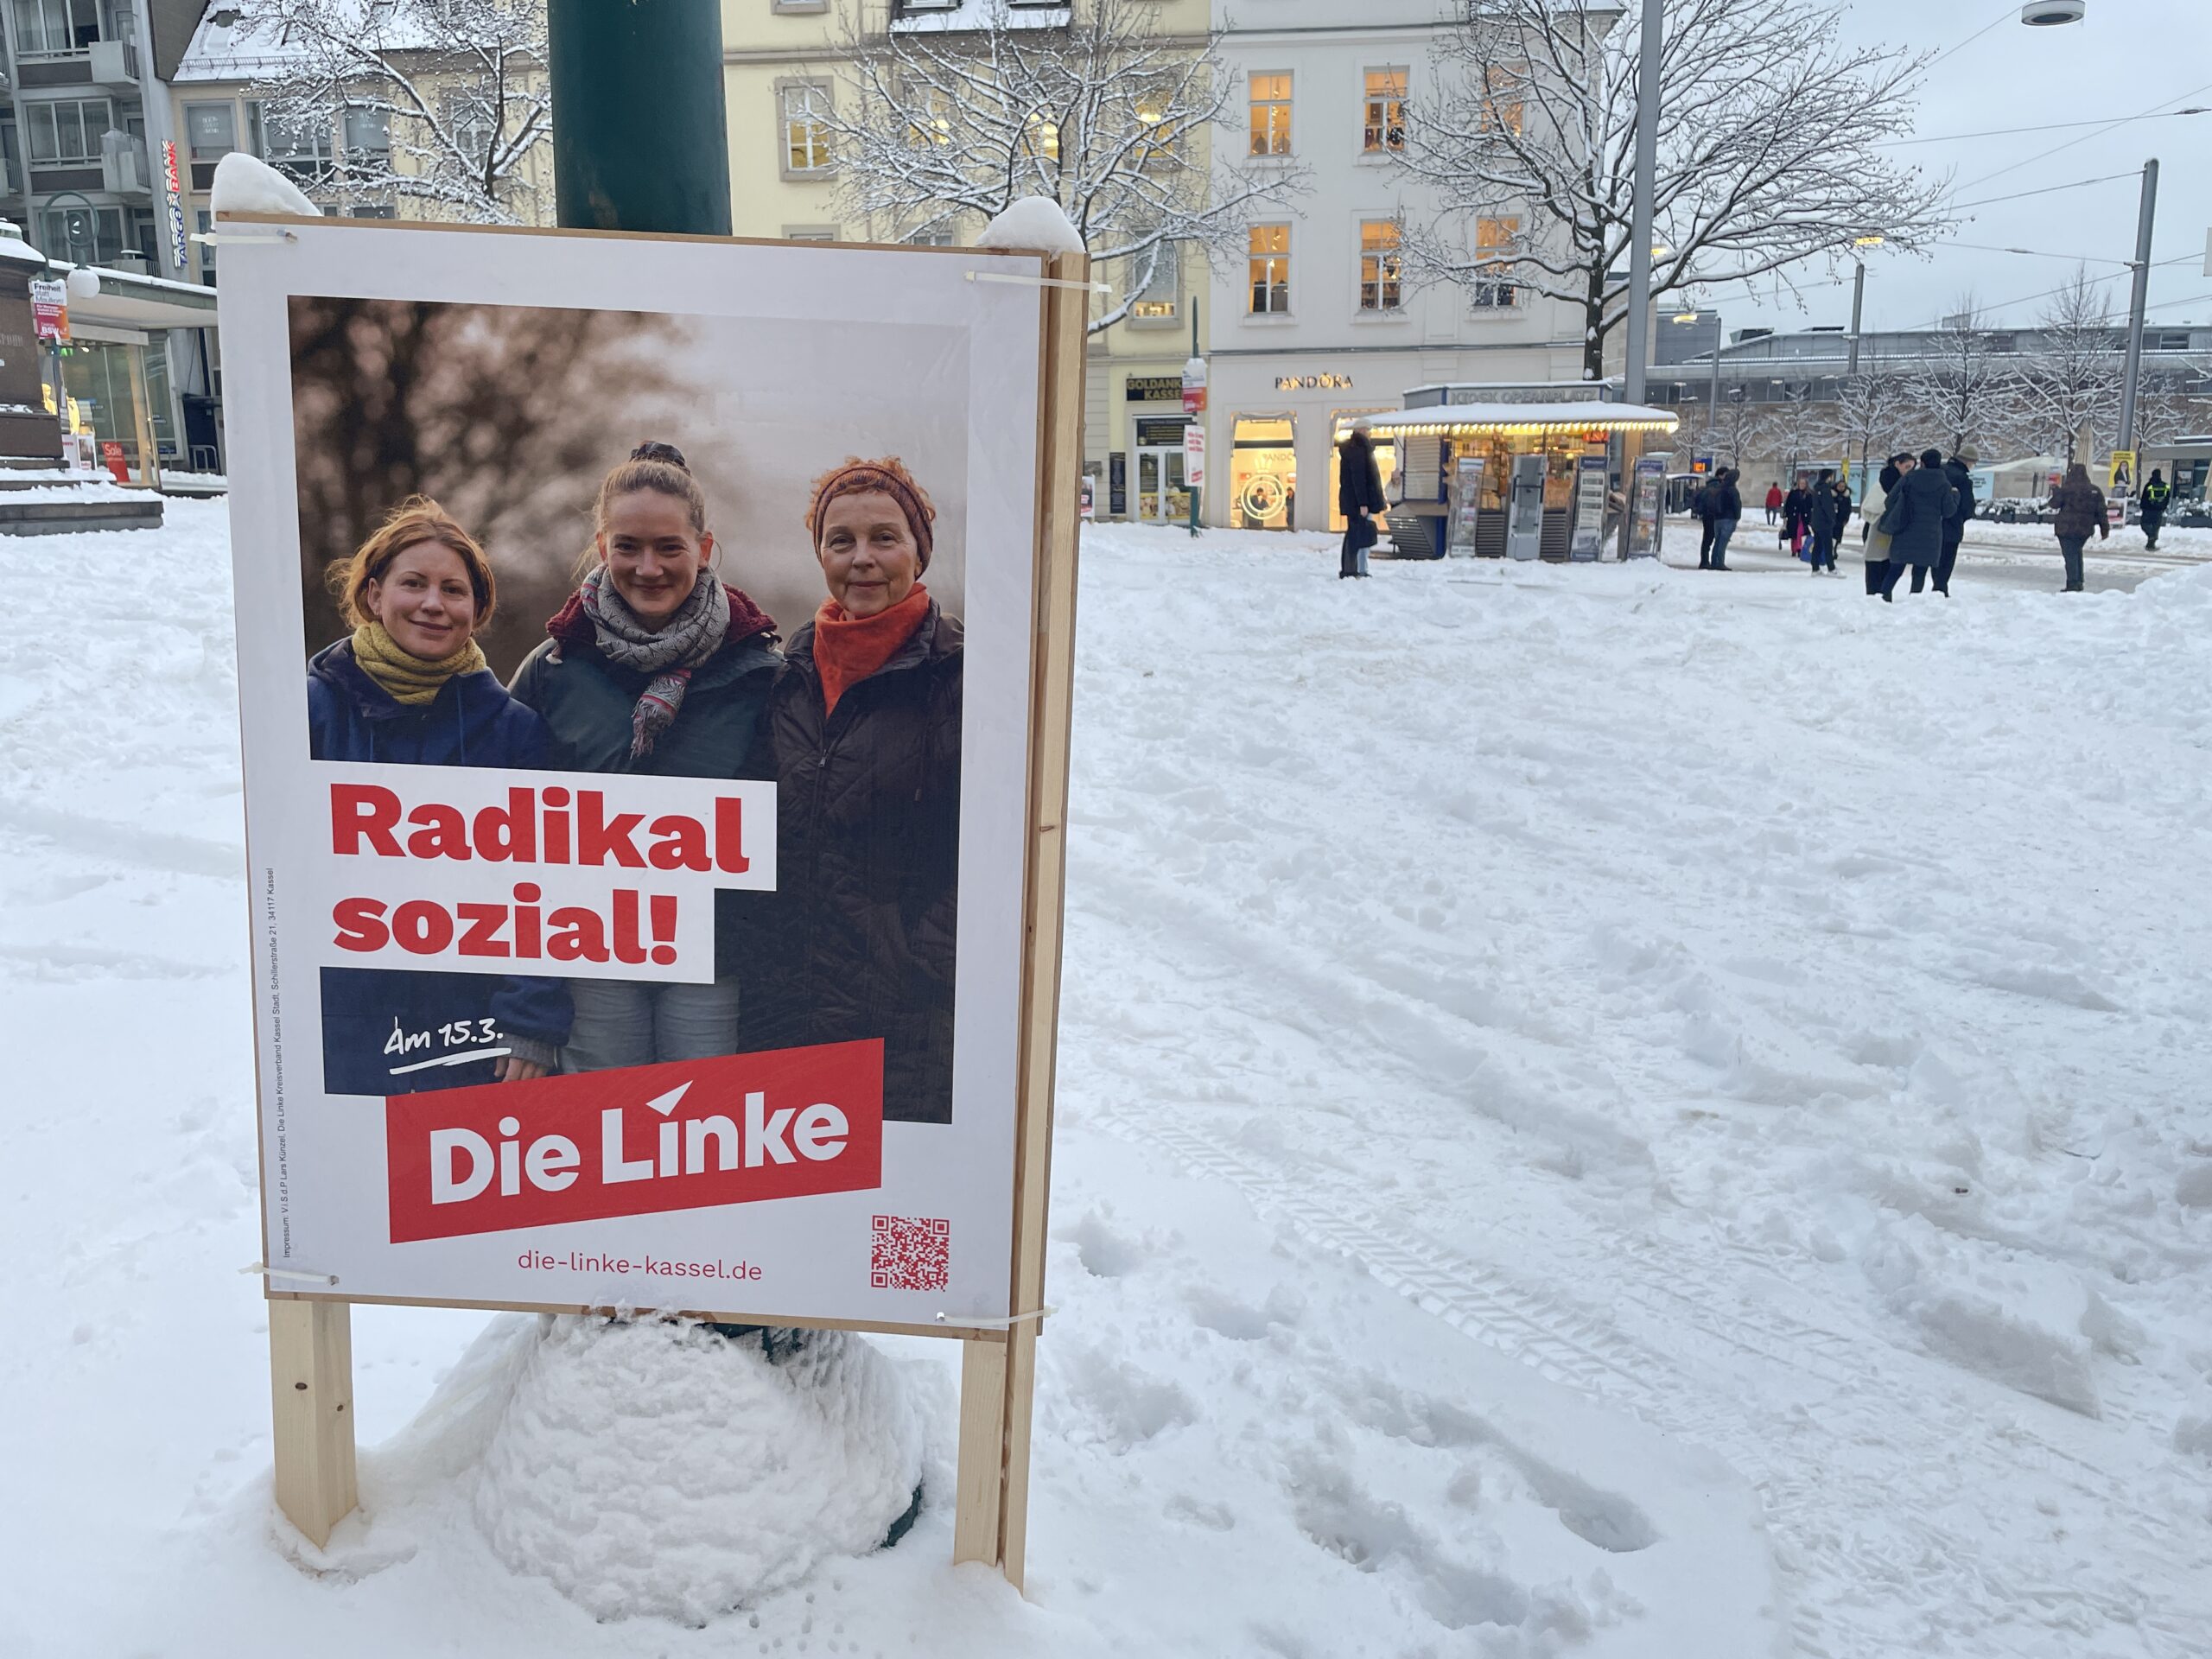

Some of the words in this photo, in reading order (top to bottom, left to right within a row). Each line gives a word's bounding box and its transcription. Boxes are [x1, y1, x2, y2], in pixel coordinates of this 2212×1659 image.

[34, 283, 61, 293] Freiheit
[1127, 378, 1182, 390] GOLDANK
[1145, 389, 1182, 400] KASSE
[1452, 391, 1497, 404] KIOSK
[1501, 389, 1596, 404] OPERNPLATZ
[1263, 454, 1294, 463] PANDO
[331, 784, 750, 874] Radikal
[332, 882, 677, 965] sozial!
[270, 938, 279, 990] Schillerstraße
[384, 1015, 431, 1055] Am
[437, 1017, 504, 1047] 15.3.
[430, 1116, 581, 1205] Die
[602, 1080, 849, 1185] Linke
[518, 1249, 762, 1281] die-linke-kassel.de
